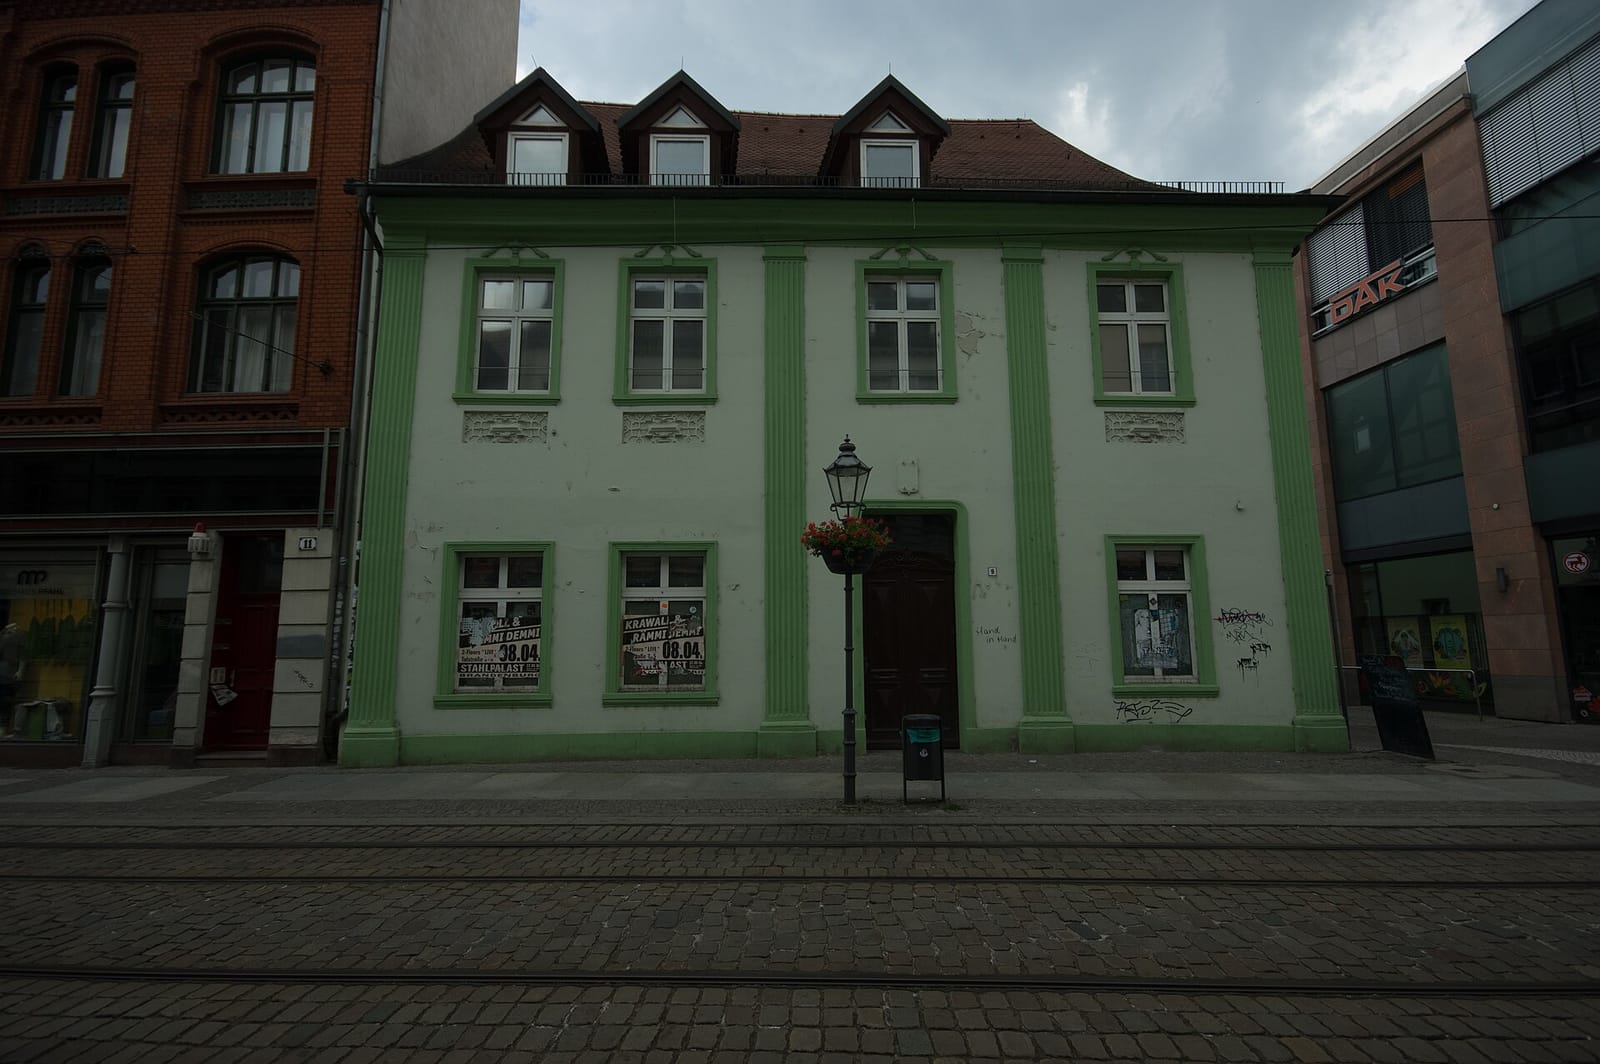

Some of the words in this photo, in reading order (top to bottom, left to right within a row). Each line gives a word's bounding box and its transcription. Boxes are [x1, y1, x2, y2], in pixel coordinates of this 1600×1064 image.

[1329, 259, 1404, 324] DAK
[304, 540, 312, 549] 11
[506, 628, 540, 641] DEMMI
[632, 629, 667, 643] RÄMMI
[662, 641, 702, 660] 08.04.
[460, 663, 525, 673] STAHLPALAST
